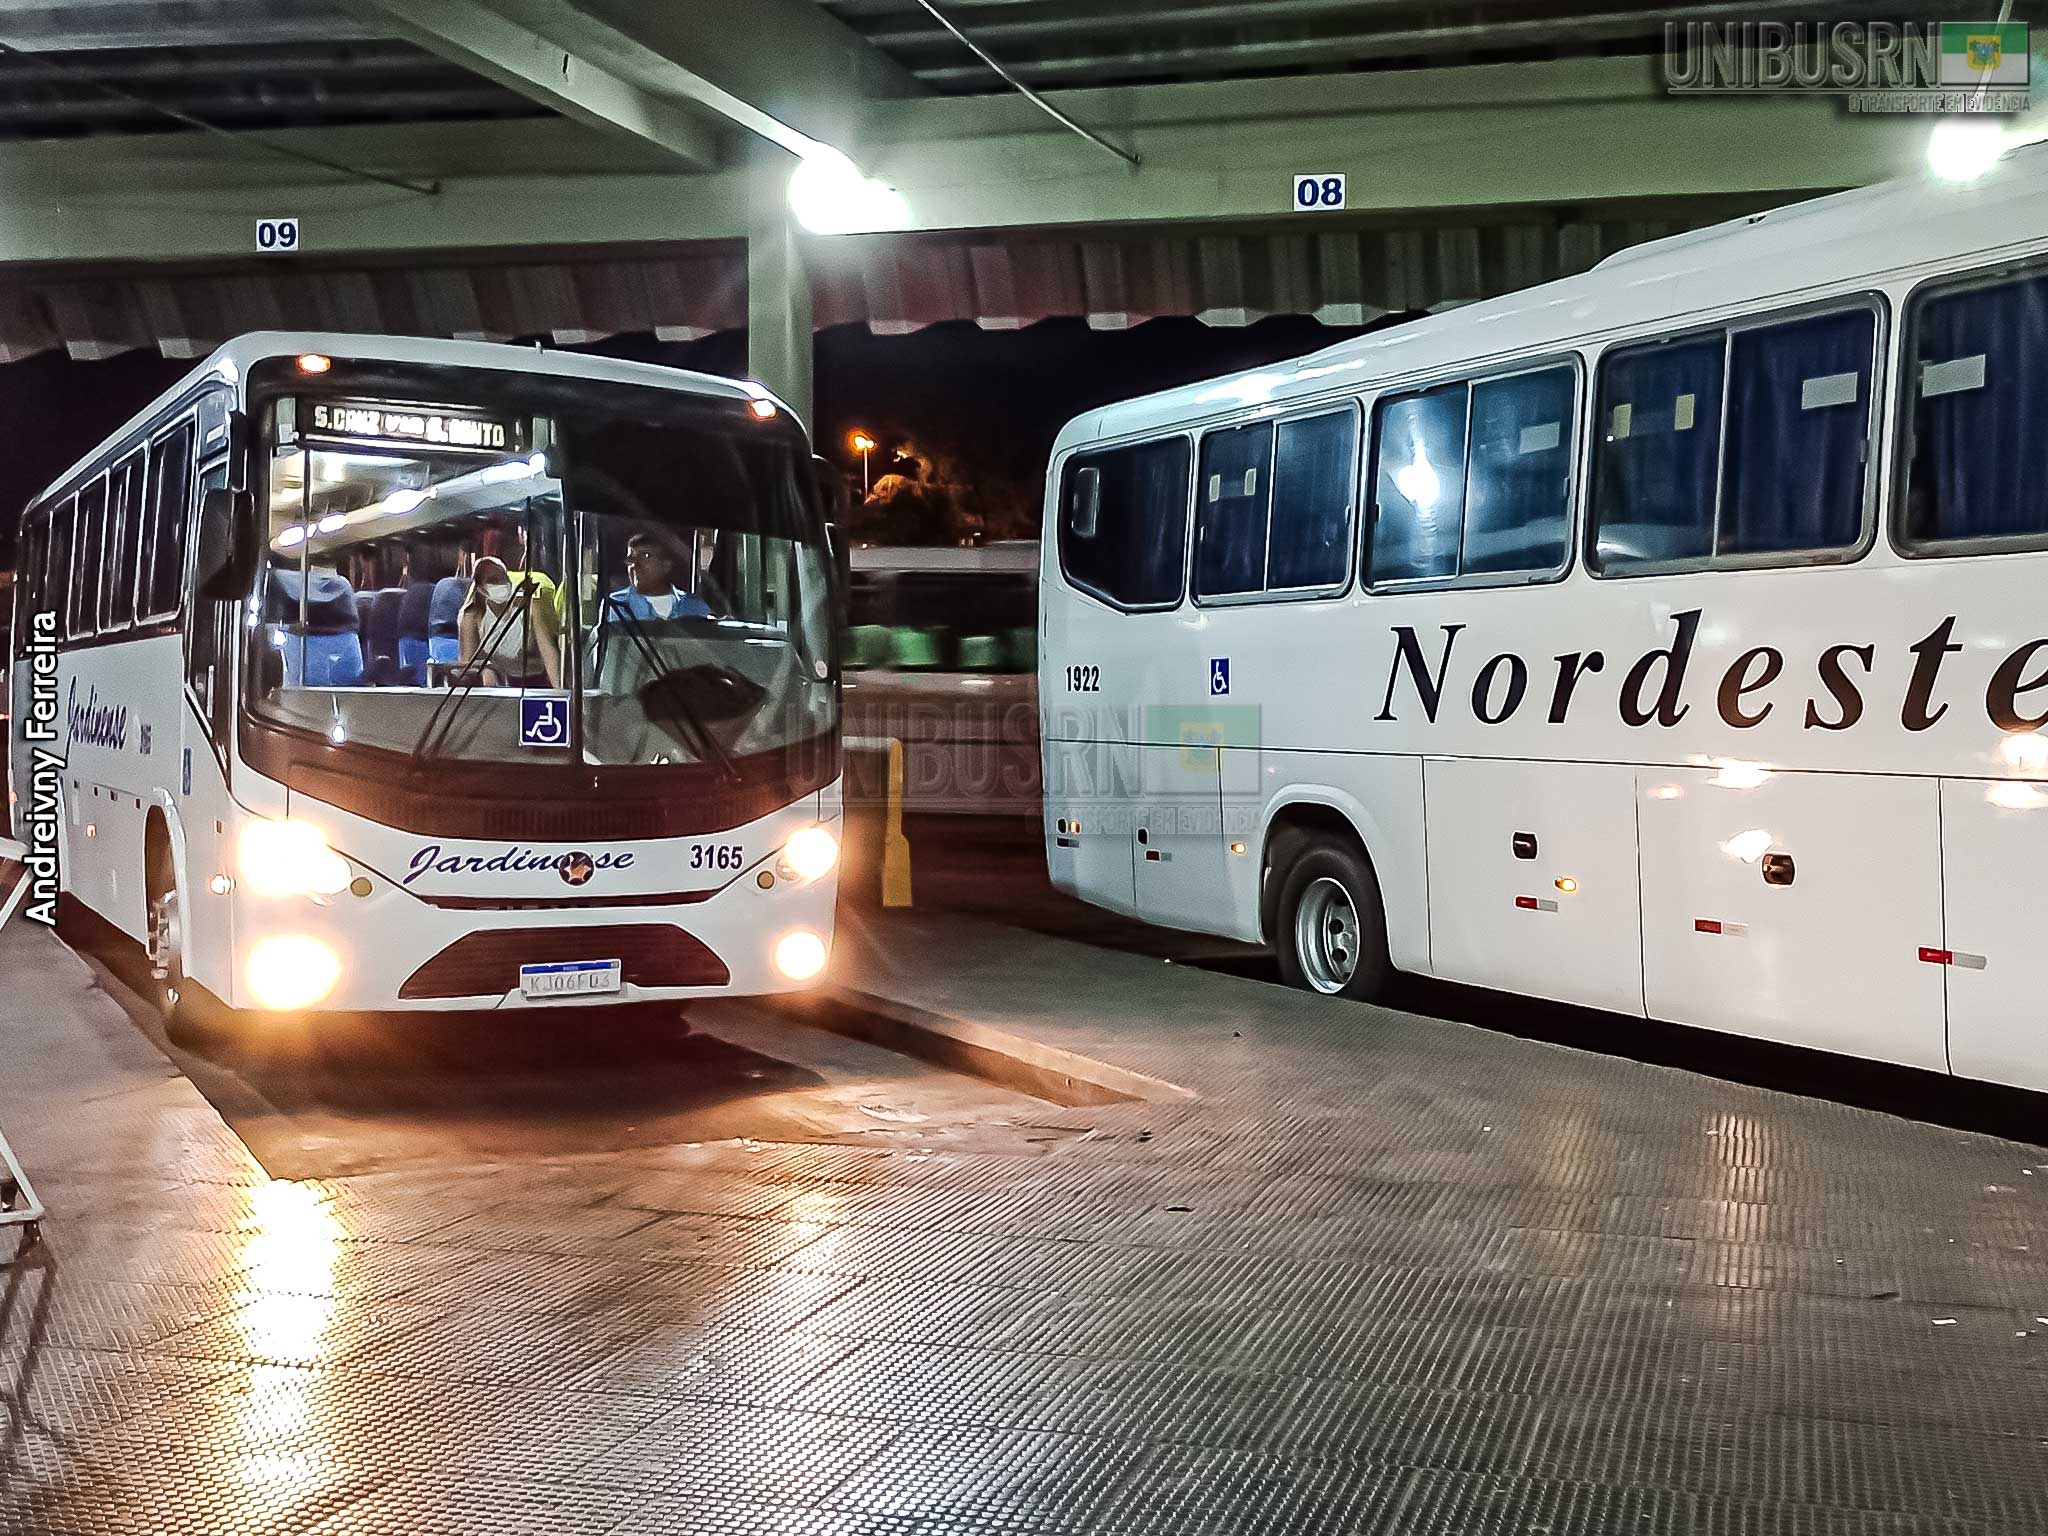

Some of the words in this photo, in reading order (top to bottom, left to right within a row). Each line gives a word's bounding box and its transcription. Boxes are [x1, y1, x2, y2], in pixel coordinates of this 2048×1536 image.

[1298, 178, 1342, 206] 08
[259, 222, 296, 248] 09
[1066, 665, 1100, 692] 1922
[1373, 608, 2048, 734] Nordeste
[403, 846, 634, 884] Jardinse
[690, 845, 743, 869] 3165
